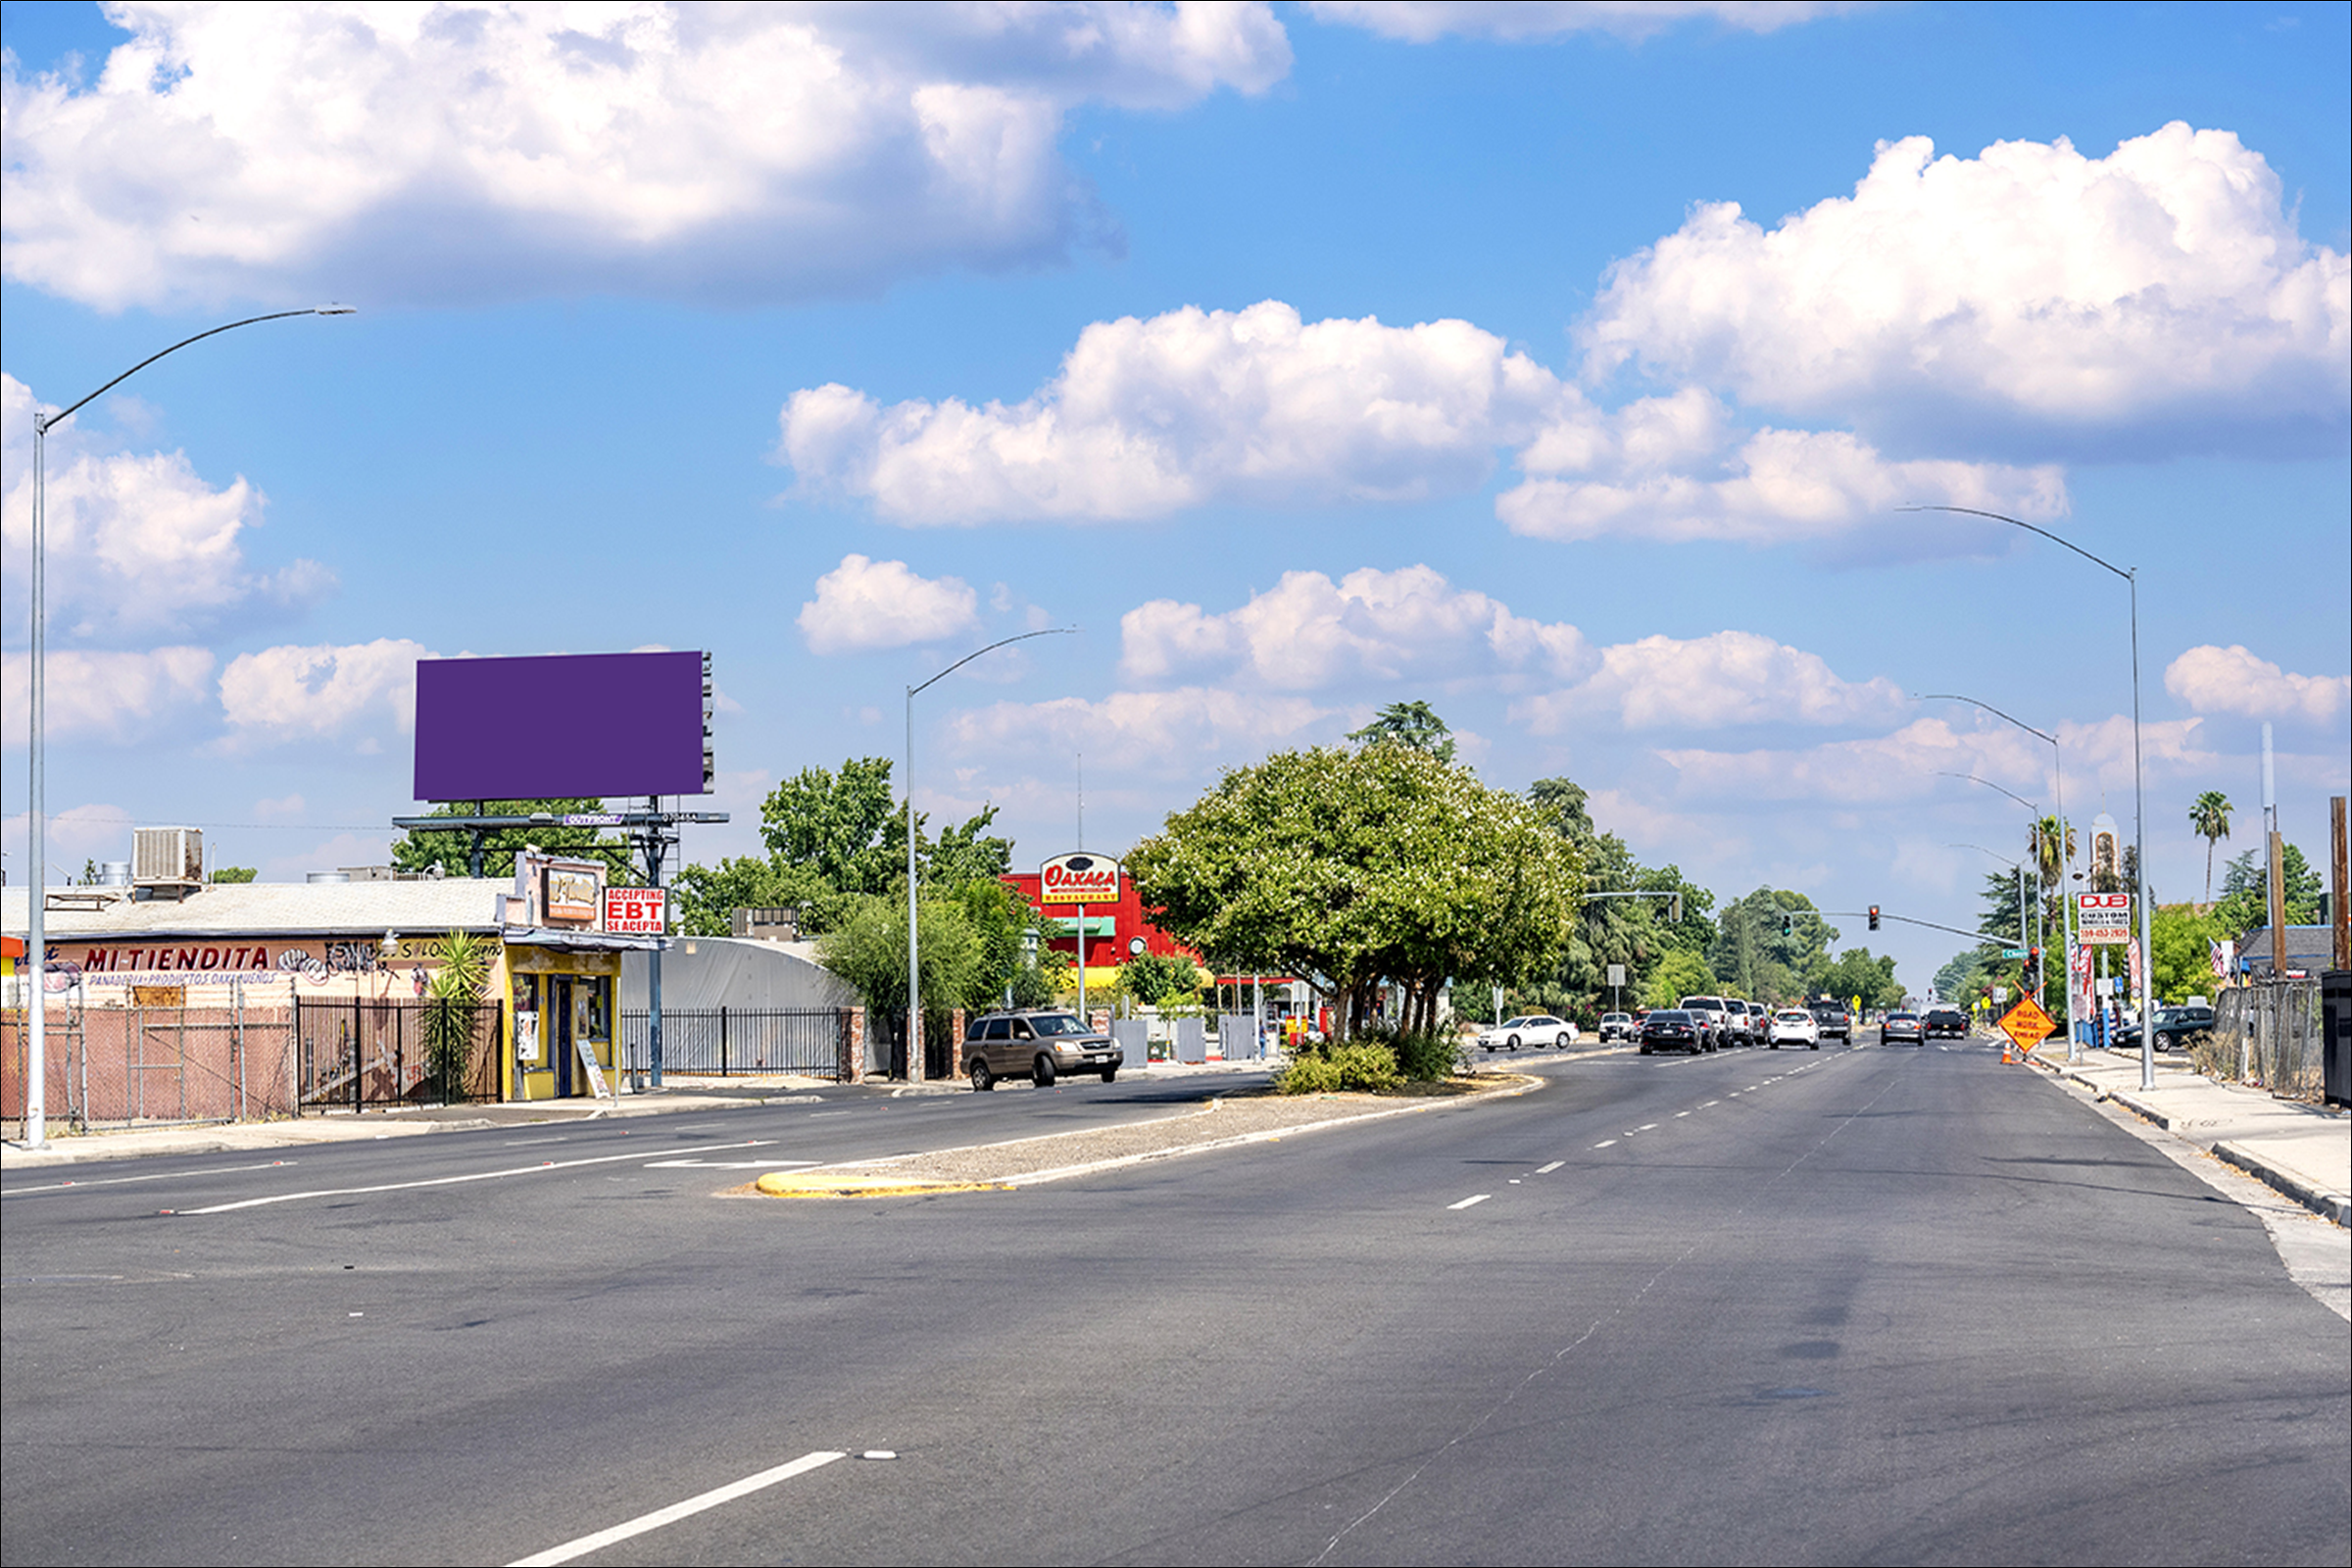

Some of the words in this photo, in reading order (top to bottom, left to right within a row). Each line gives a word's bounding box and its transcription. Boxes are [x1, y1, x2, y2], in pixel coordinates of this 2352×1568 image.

[608, 889, 664, 901] ACCEPTING
[2081, 894, 2128, 908] DUB
[608, 902, 662, 919] EBT
[607, 920, 619, 932] SE
[621, 920, 662, 932] ACEPTA
[128, 947, 270, 971] TIENDITA
[211, 970, 278, 986] OAXAUEÑOS
[2017, 1009, 2039, 1019] ROAD
[2016, 1020, 2038, 1029] WORK
[2014, 1031, 2040, 1040] AHEAD
